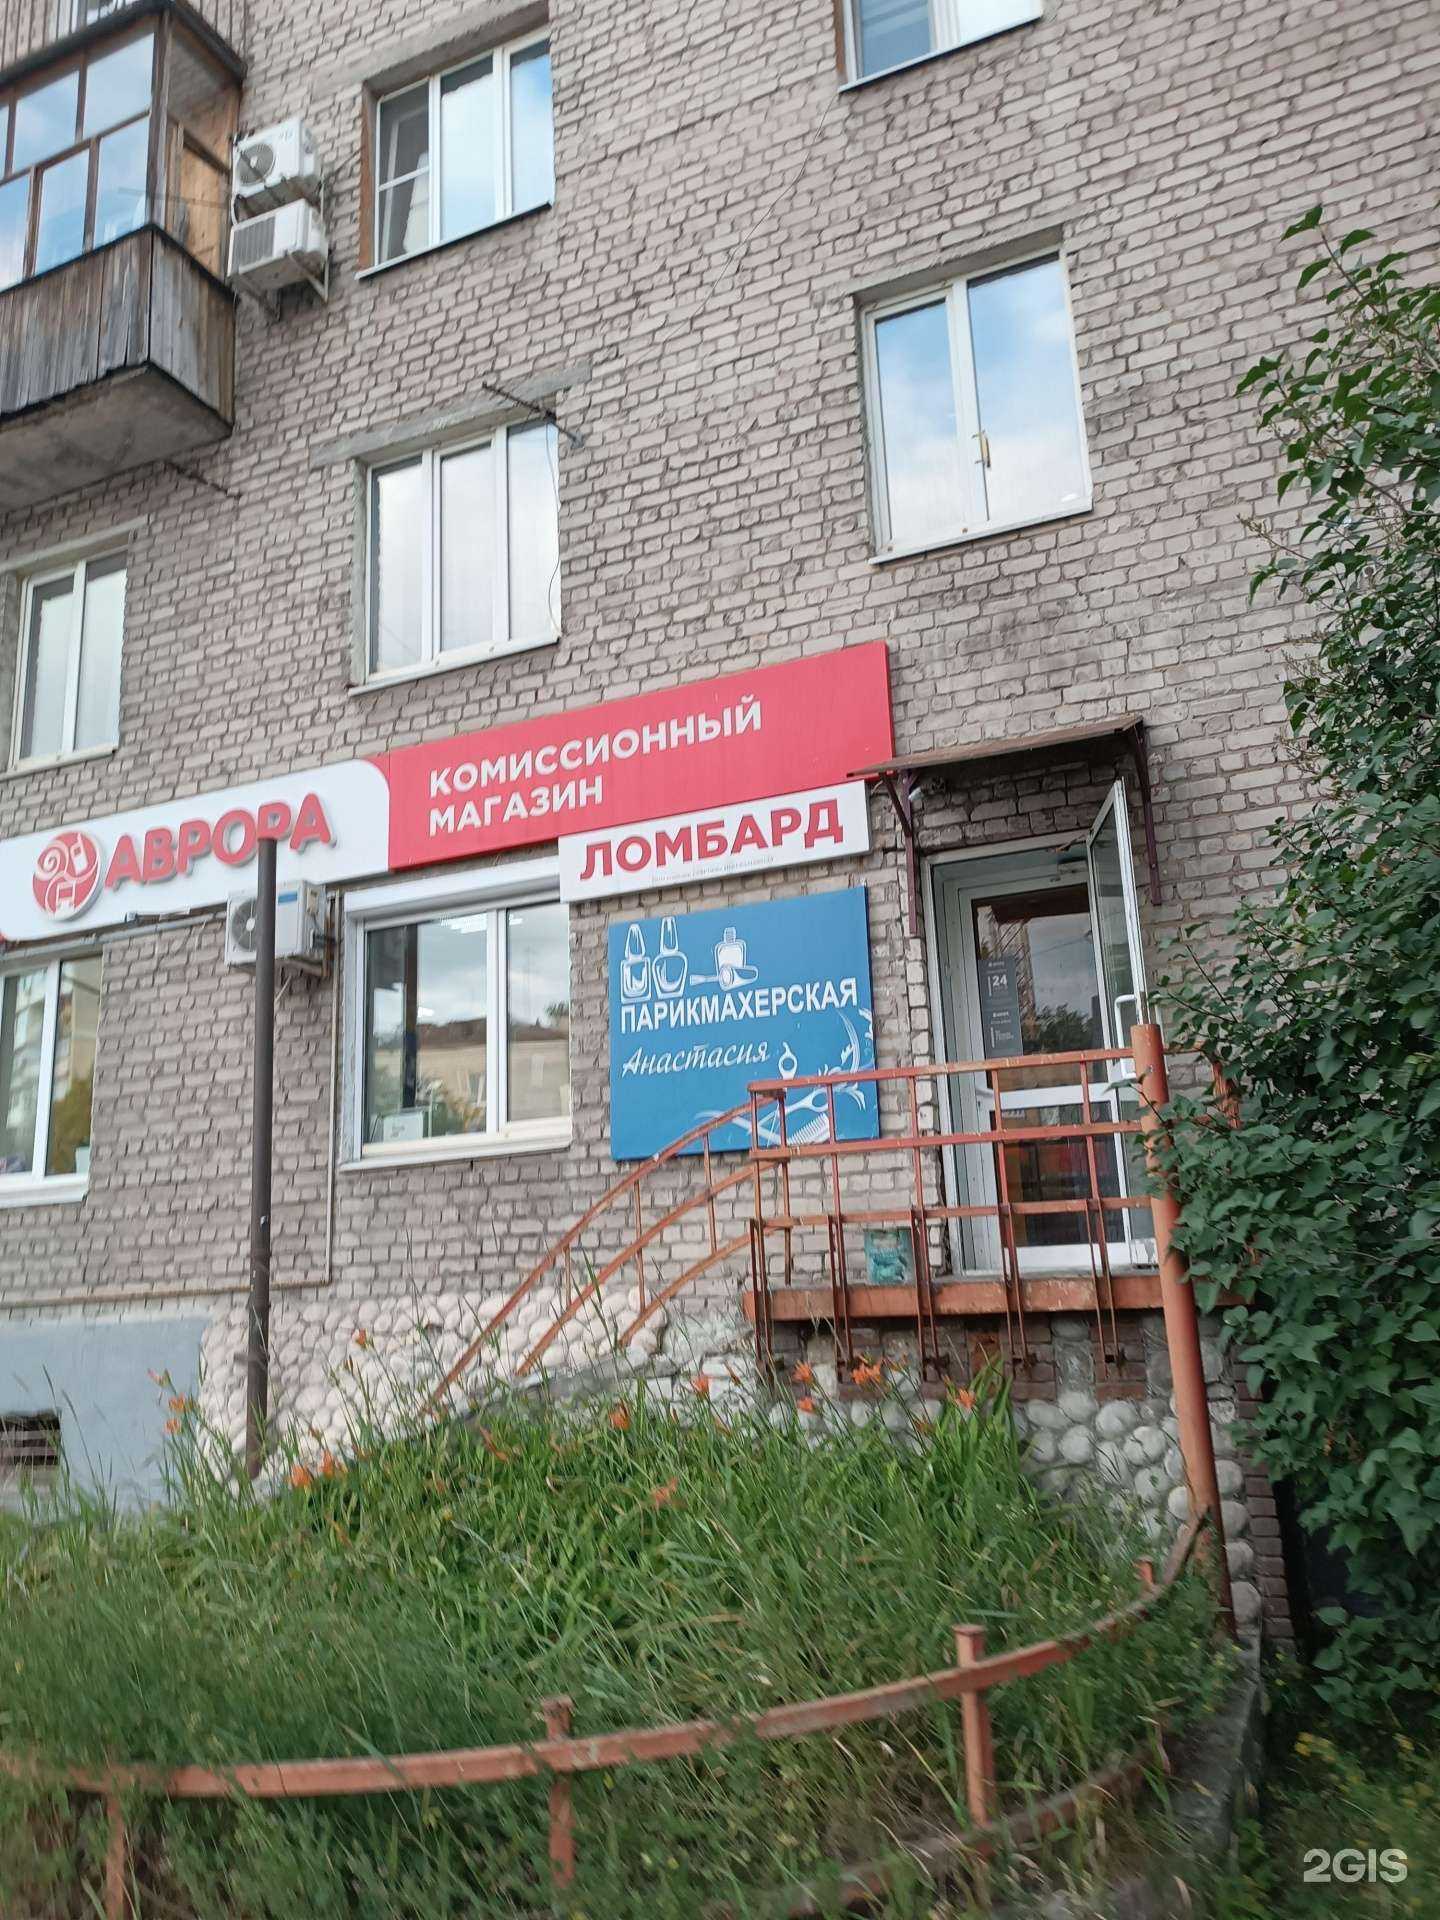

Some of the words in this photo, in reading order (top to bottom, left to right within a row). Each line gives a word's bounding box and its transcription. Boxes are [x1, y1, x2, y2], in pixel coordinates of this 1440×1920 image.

[428, 695, 763, 798] КОМИССИОННЫЙ
[105, 793, 333, 890] АВРОРА
[428, 776, 604, 837] МАГАЗИН
[579, 798, 845, 881] ЛОМБАРД
[621, 977, 858, 1034] ПАРИКМАХЕРСКАЯ
[621, 1041, 771, 1079] Анастасия
